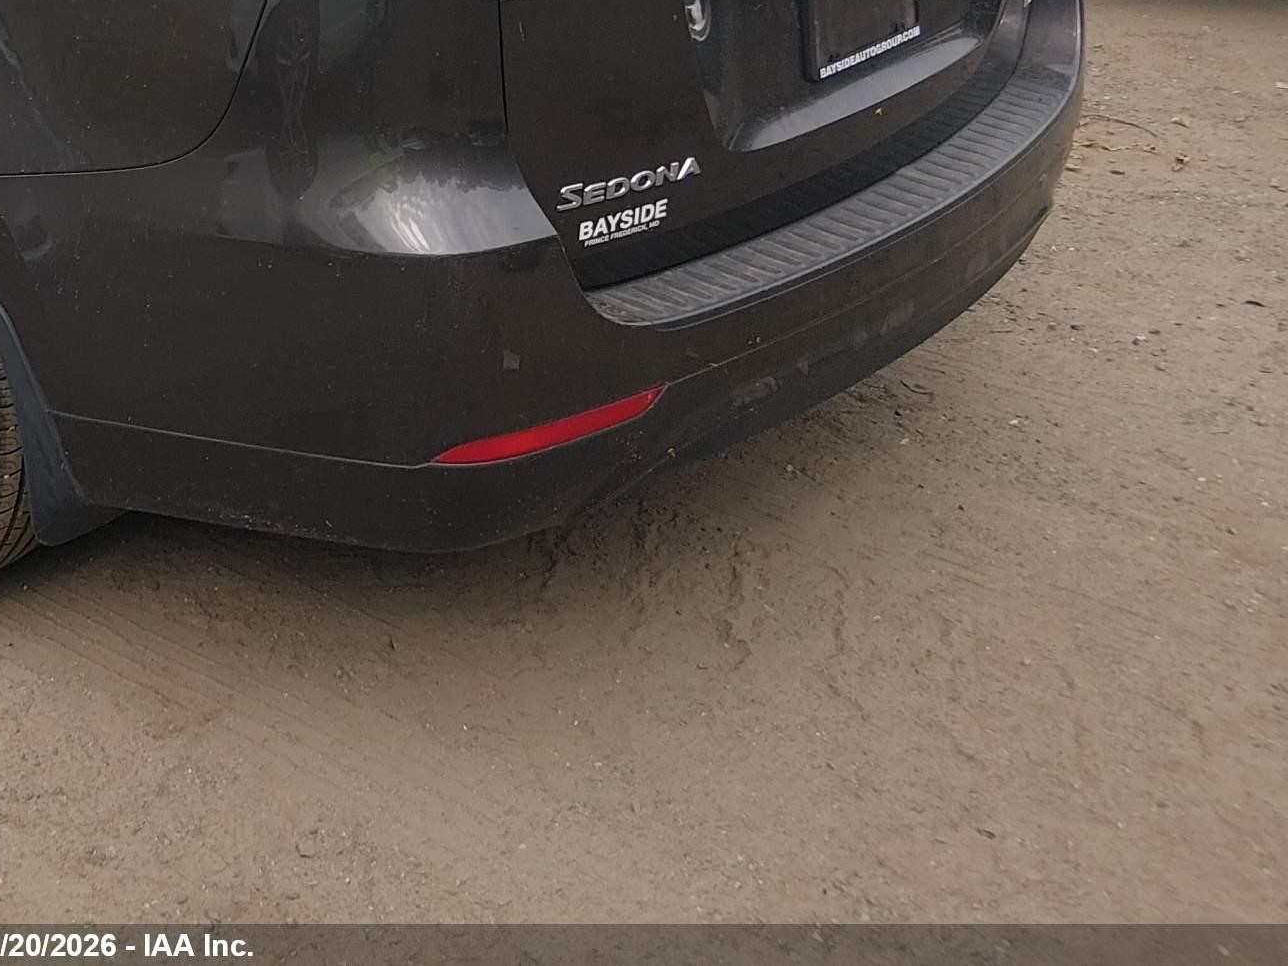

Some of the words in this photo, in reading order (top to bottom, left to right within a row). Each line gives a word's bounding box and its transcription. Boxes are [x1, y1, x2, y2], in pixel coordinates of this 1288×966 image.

[556, 156, 702, 212] SEDONA
[578, 198, 669, 242] BAYSIDE
[584, 235, 610, 248] PRINCE
[649, 220, 661, 229] MD
